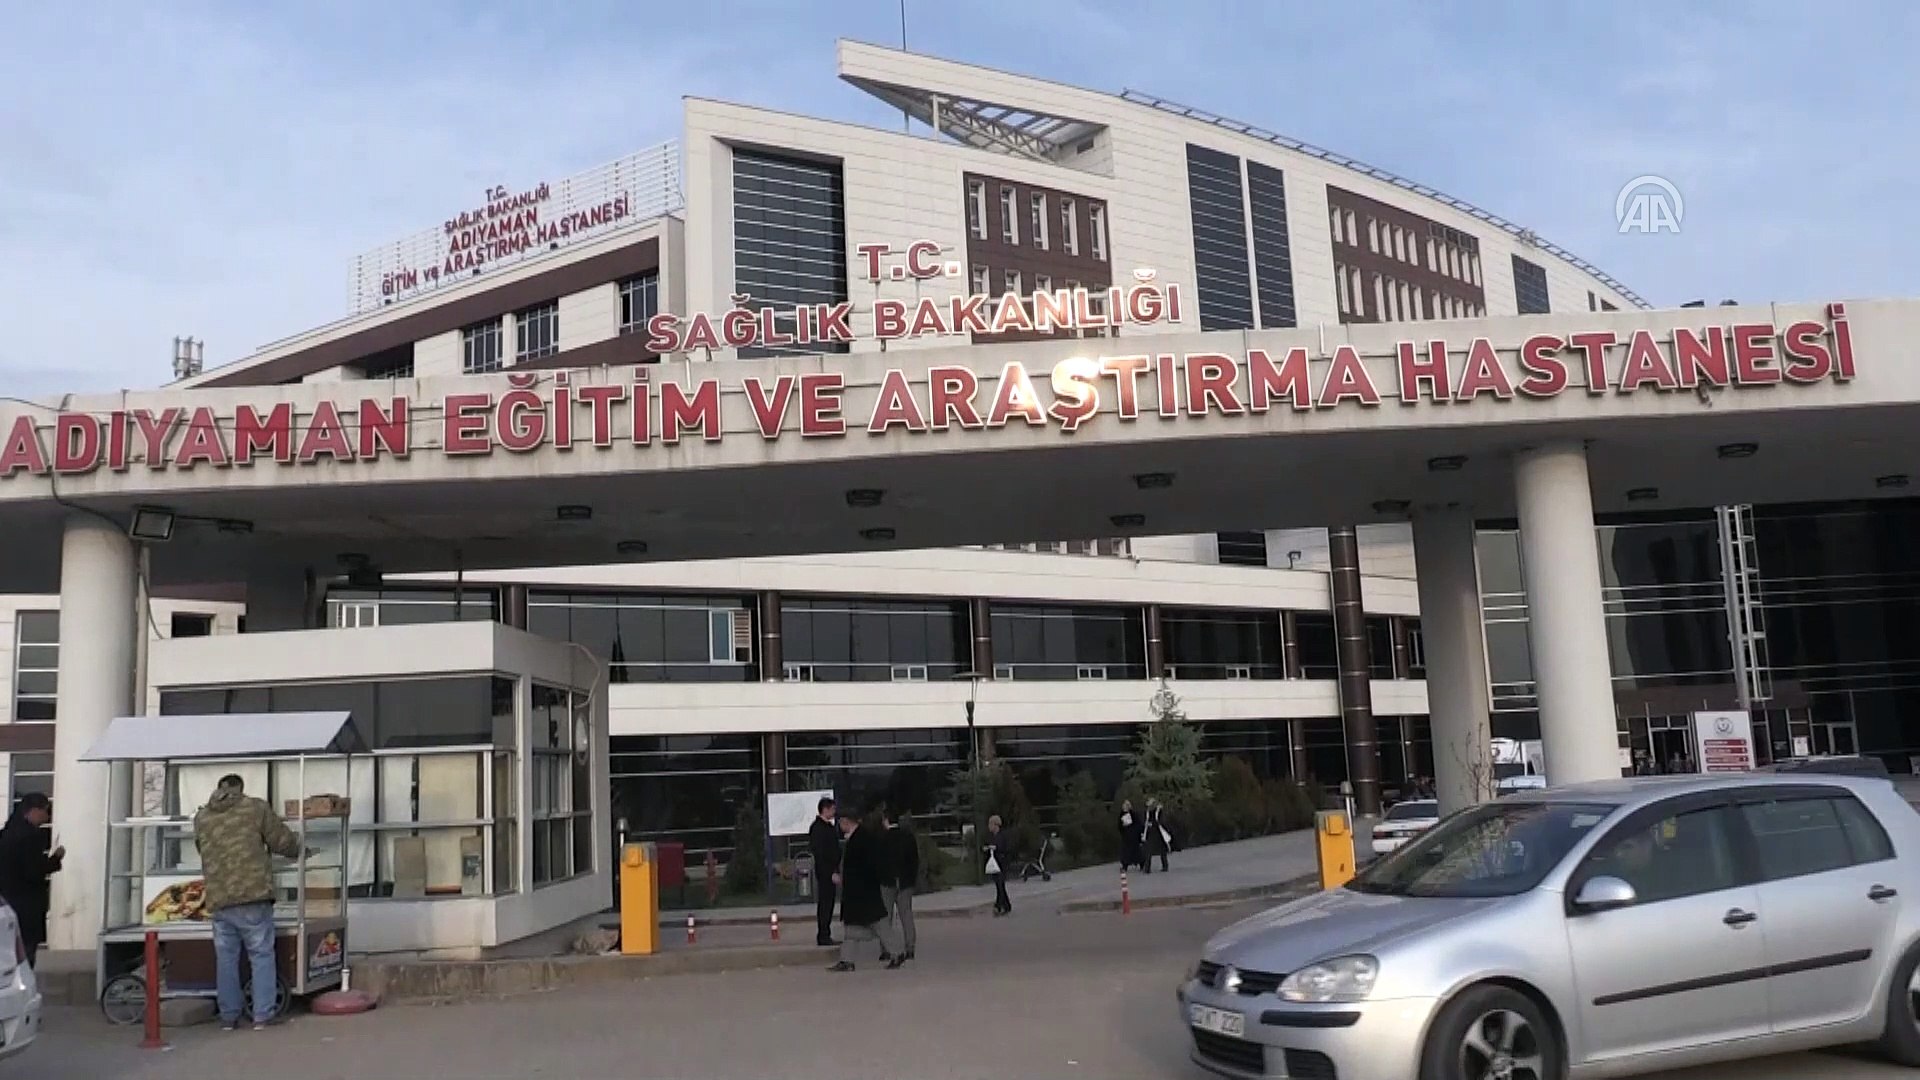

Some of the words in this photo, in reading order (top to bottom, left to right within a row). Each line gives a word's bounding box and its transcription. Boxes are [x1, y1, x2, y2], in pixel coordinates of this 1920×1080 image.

[445, 207, 484, 234] SAĞLIK
[487, 181, 550, 219] BAKANLIĞI
[485, 184, 508, 202] T.C.
[443, 231, 533, 276] ARAŞTIRMA
[536, 189, 629, 245] HASTANESİ
[450, 206, 538, 254] ADIYAMAN
[857, 240, 962, 284] T.C.
[645, 293, 857, 352] SAĞLIK
[872, 268, 1183, 340] BAKANLIĞI
[0, 396, 411, 478] ADIYAMAN
[442, 366, 723, 456] EĞİTİM
[742, 372, 847, 440] VE
[866, 344, 1381, 435] ARAŞTIRMA
[1396, 302, 1858, 404] HASTANESİ
